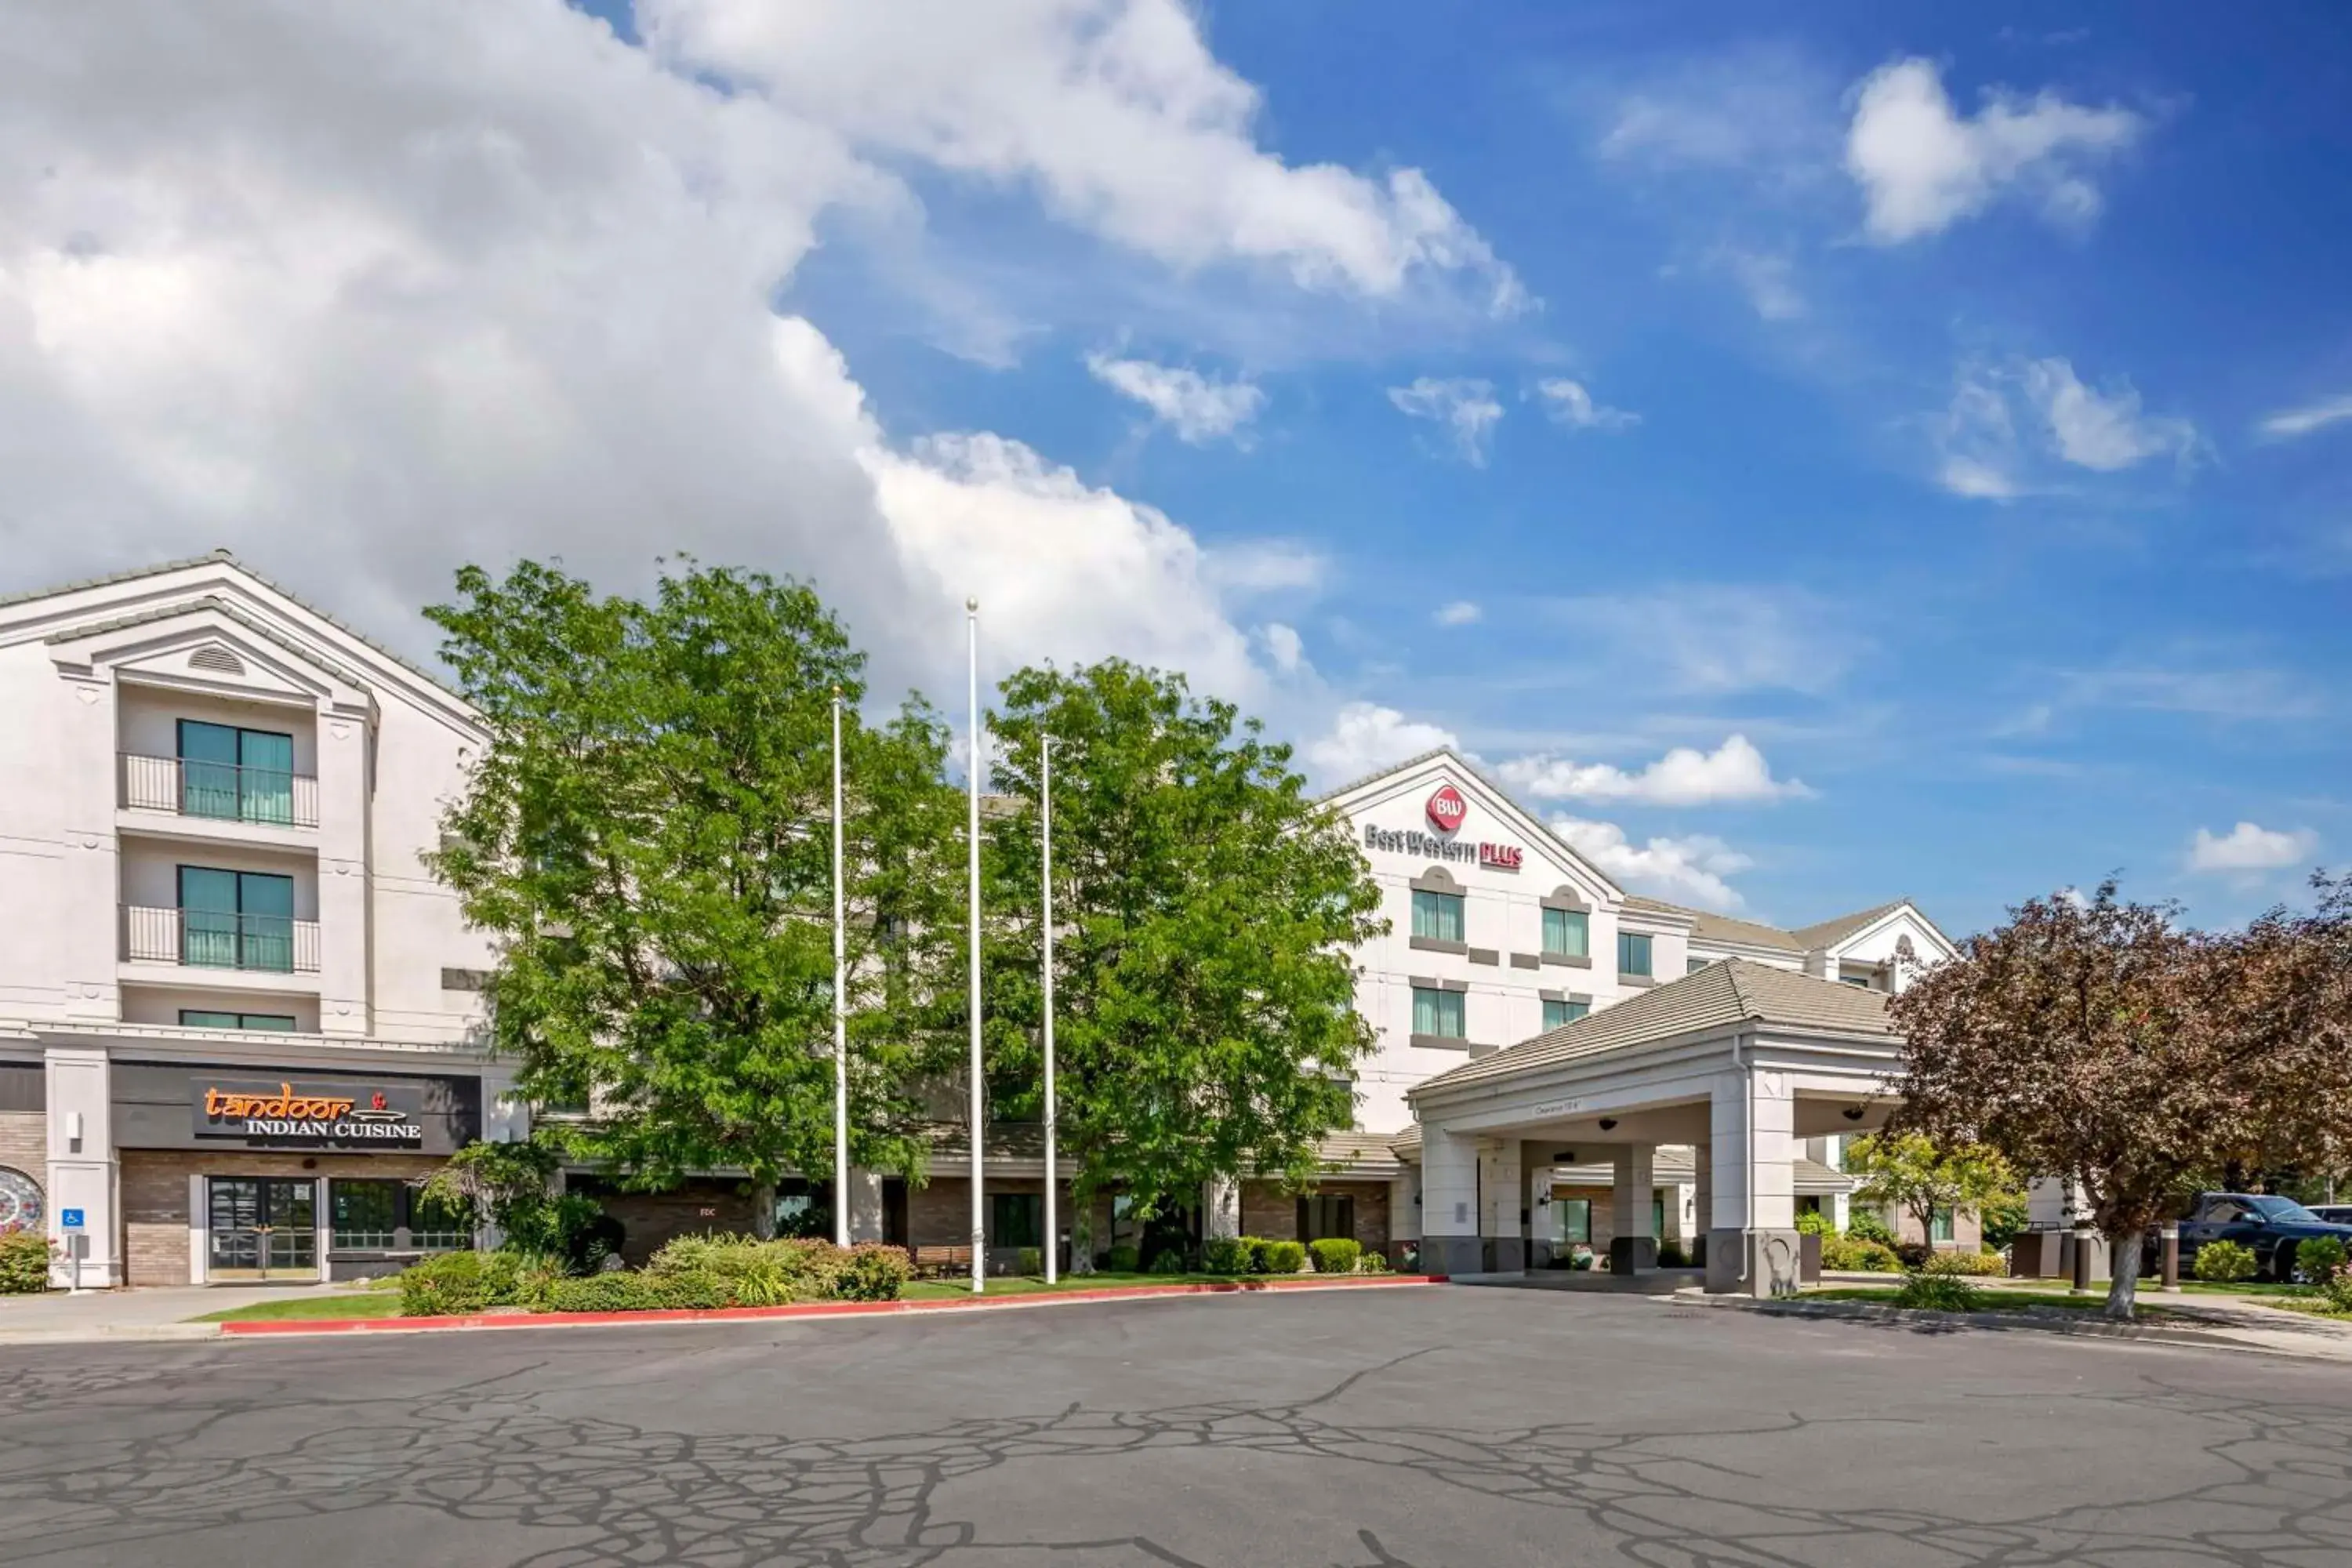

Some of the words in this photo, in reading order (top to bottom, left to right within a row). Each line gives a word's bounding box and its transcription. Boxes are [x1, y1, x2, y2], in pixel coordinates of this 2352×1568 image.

[1436, 798, 1462, 816] BW
[1365, 824, 1404, 851] Best
[1406, 830, 1476, 863] Western
[1479, 841, 1523, 866] PLUS
[205, 1080, 354, 1120] tandoor
[247, 1120, 329, 1136] INDIAN
[334, 1123, 421, 1139] CUISINE
